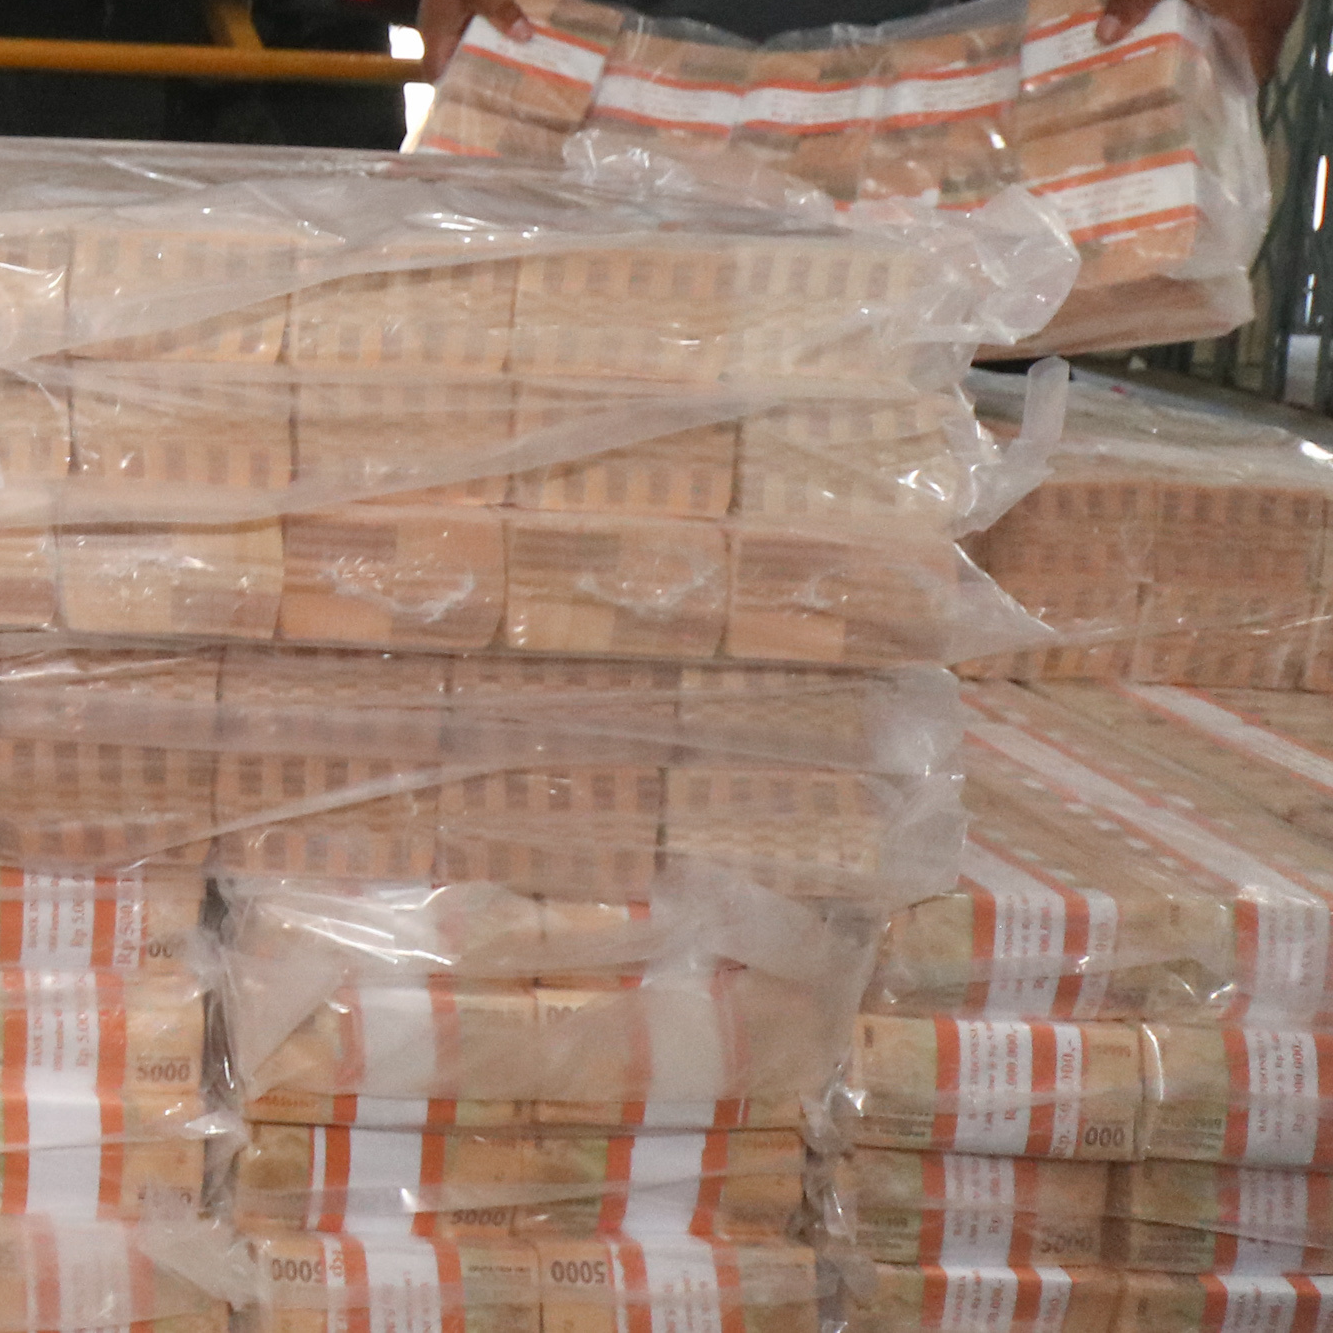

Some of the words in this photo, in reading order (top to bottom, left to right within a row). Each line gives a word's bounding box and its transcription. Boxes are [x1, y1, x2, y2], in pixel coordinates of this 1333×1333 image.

[71, 928, 88, 947] Rp
[116, 937, 138, 965] Rp
[77, 1048, 93, 1067] Rp
[137, 1063, 191, 1083] 5000
[551, 1260, 606, 1283] 5000
